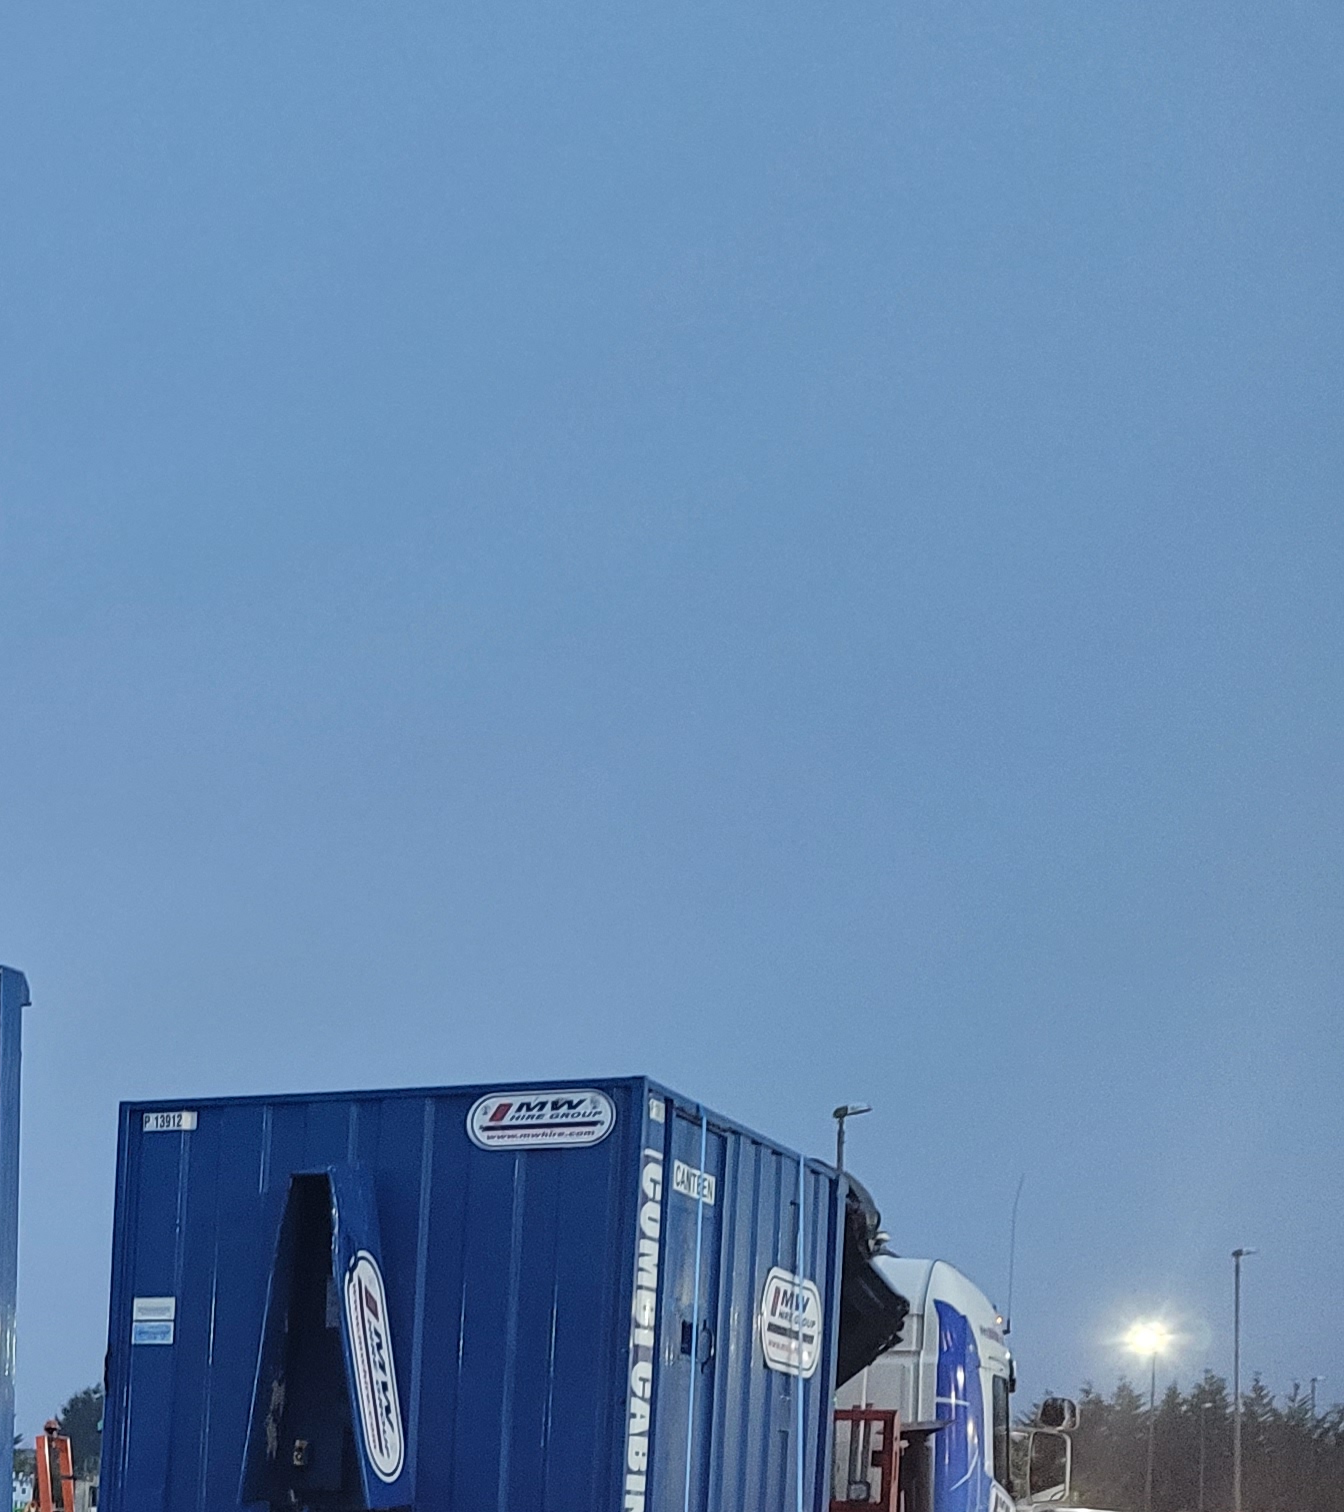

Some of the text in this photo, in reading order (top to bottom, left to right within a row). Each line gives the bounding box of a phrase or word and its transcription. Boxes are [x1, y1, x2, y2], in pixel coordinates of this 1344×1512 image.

[515, 1098, 587, 1113] MW
[144, 1113, 182, 1129] P 13912
[510, 1110, 603, 1122] HIRE GROUP
[486, 1129, 595, 1141] www.mwhire.com
[675, 1164, 713, 1201] CANTEEN
[633, 1161, 663, 1347] COMBI
